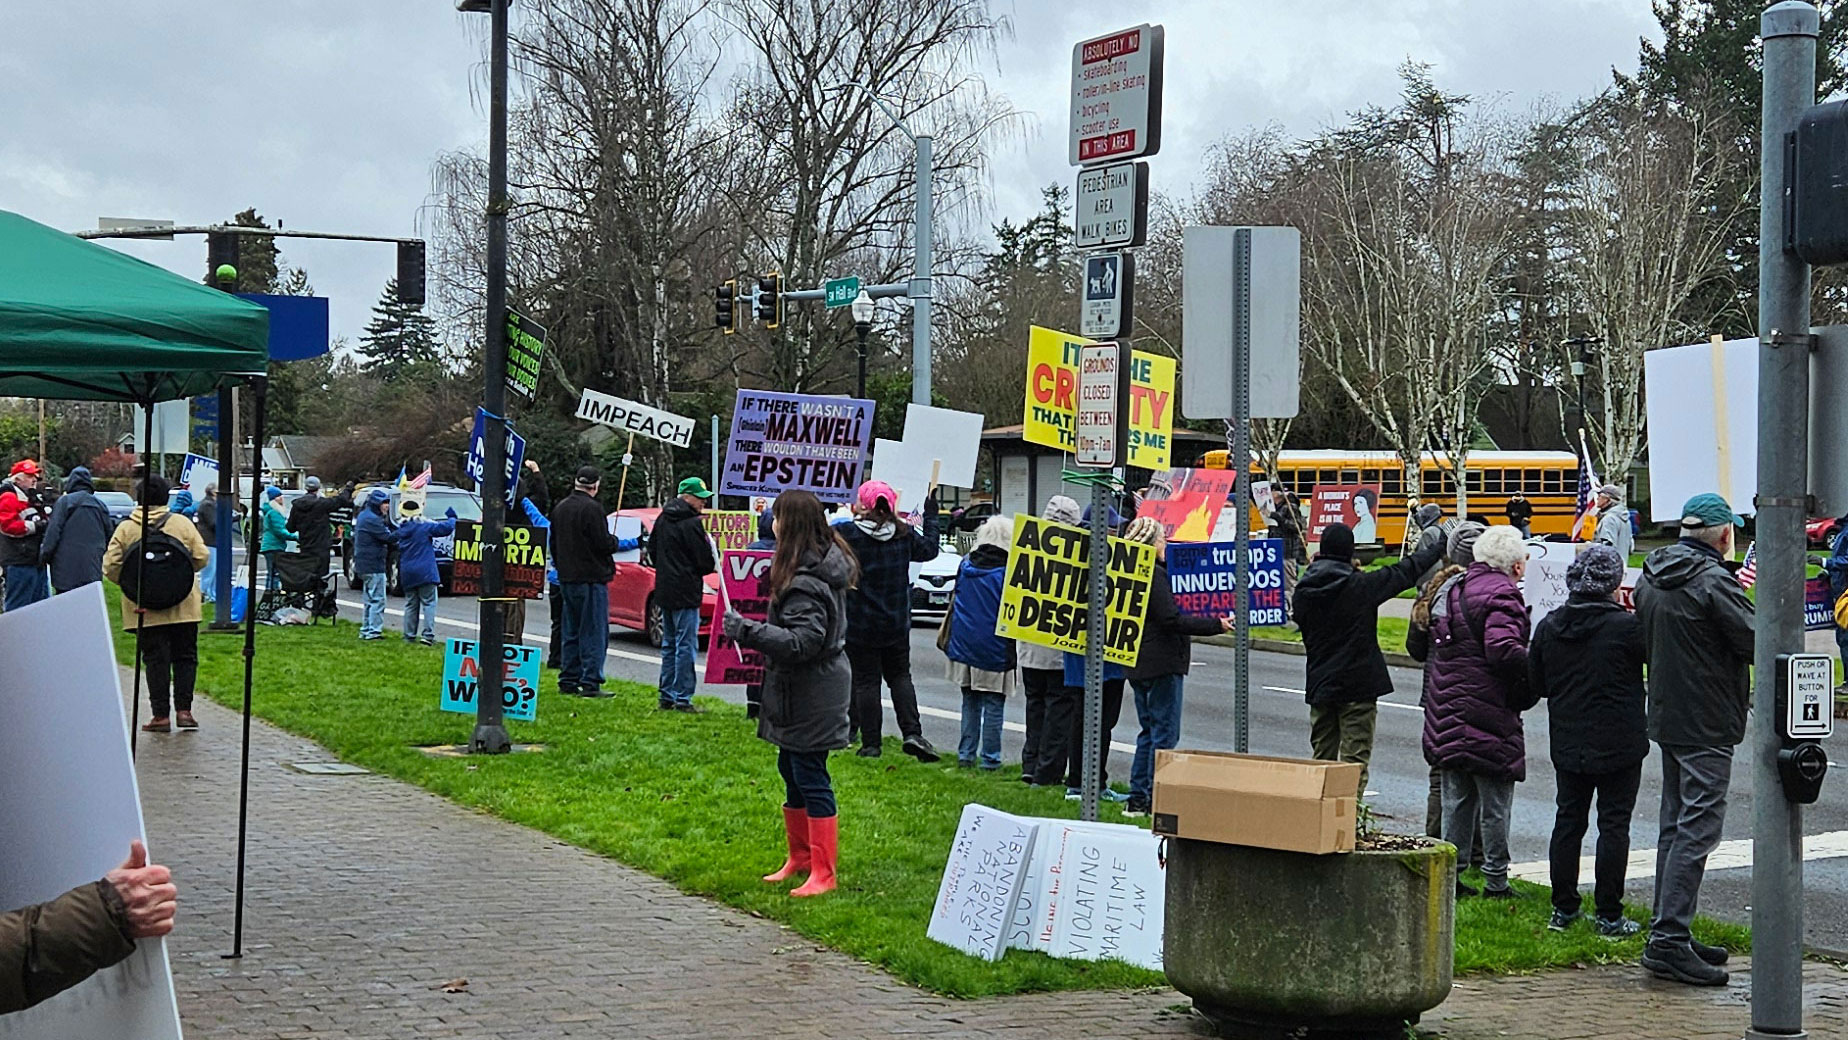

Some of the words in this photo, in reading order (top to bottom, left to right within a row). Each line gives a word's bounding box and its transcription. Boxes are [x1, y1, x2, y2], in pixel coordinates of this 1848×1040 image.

[1084, 37, 1125, 61] ABSOLUTELY
[1128, 34, 1138, 50] NO
[1083, 60, 1127, 80] skateboarding
[1122, 75, 1145, 90] skating
[1082, 101, 1109, 118] bicycling
[1082, 120, 1106, 135] scooter
[1108, 118, 1119, 131] use
[1082, 144, 1089, 156] IN
[1093, 139, 1108, 154] THIS
[1111, 134, 1129, 150] AREA
[1082, 171, 1128, 194] PEDESTRIAN
[1094, 198, 1114, 216] AREA
[1081, 223, 1101, 240] WALK
[1105, 219, 1127, 237] BIKES
[1084, 357, 1115, 374] GROUNDS
[1033, 362, 1170, 430] CRTY
[1083, 384, 1111, 400] CLOSED
[742, 396, 754, 410] IF
[757, 398, 799, 414] THERE
[801, 402, 855, 419] WASN'T
[855, 407, 865, 420] A
[1032, 406, 1072, 429] THAT
[1080, 411, 1113, 426] BETWEEN
[583, 398, 691, 445] IMPEACH
[766, 413, 862, 447] MAXWELL
[735, 439, 763, 453] THERE
[811, 445, 838, 459] HAVE
[838, 447, 859, 460] BEEN
[1144, 428, 1166, 450] ME
[730, 463, 745, 473] AN
[743, 454, 858, 490] EPSTEIN
[1016, 520, 1139, 575] ACTIN
[1254, 589, 1281, 608] THE
[1004, 602, 1016, 621] TO
[1017, 596, 1140, 653] DESPIR
[1804, 610, 1836, 625] RUMP
[453, 641, 475, 655] IF
[503, 646, 535, 663] OT
[1797, 661, 1816, 669] PUSH
[1817, 661, 1826, 669] OR
[1797, 672, 1816, 680] WAVE
[447, 679, 535, 710] WO?
[1798, 683, 1825, 691] BUTTON
[1804, 694, 1818, 702] FOR
[960, 848, 994, 926] PARKS
[967, 840, 1007, 945] NATIONAL
[980, 826, 1027, 962] ABANDONING
[1069, 846, 1100, 954] VIOLATING
[1100, 857, 1127, 959] MARITIME
[1129, 883, 1147, 931] LAW
